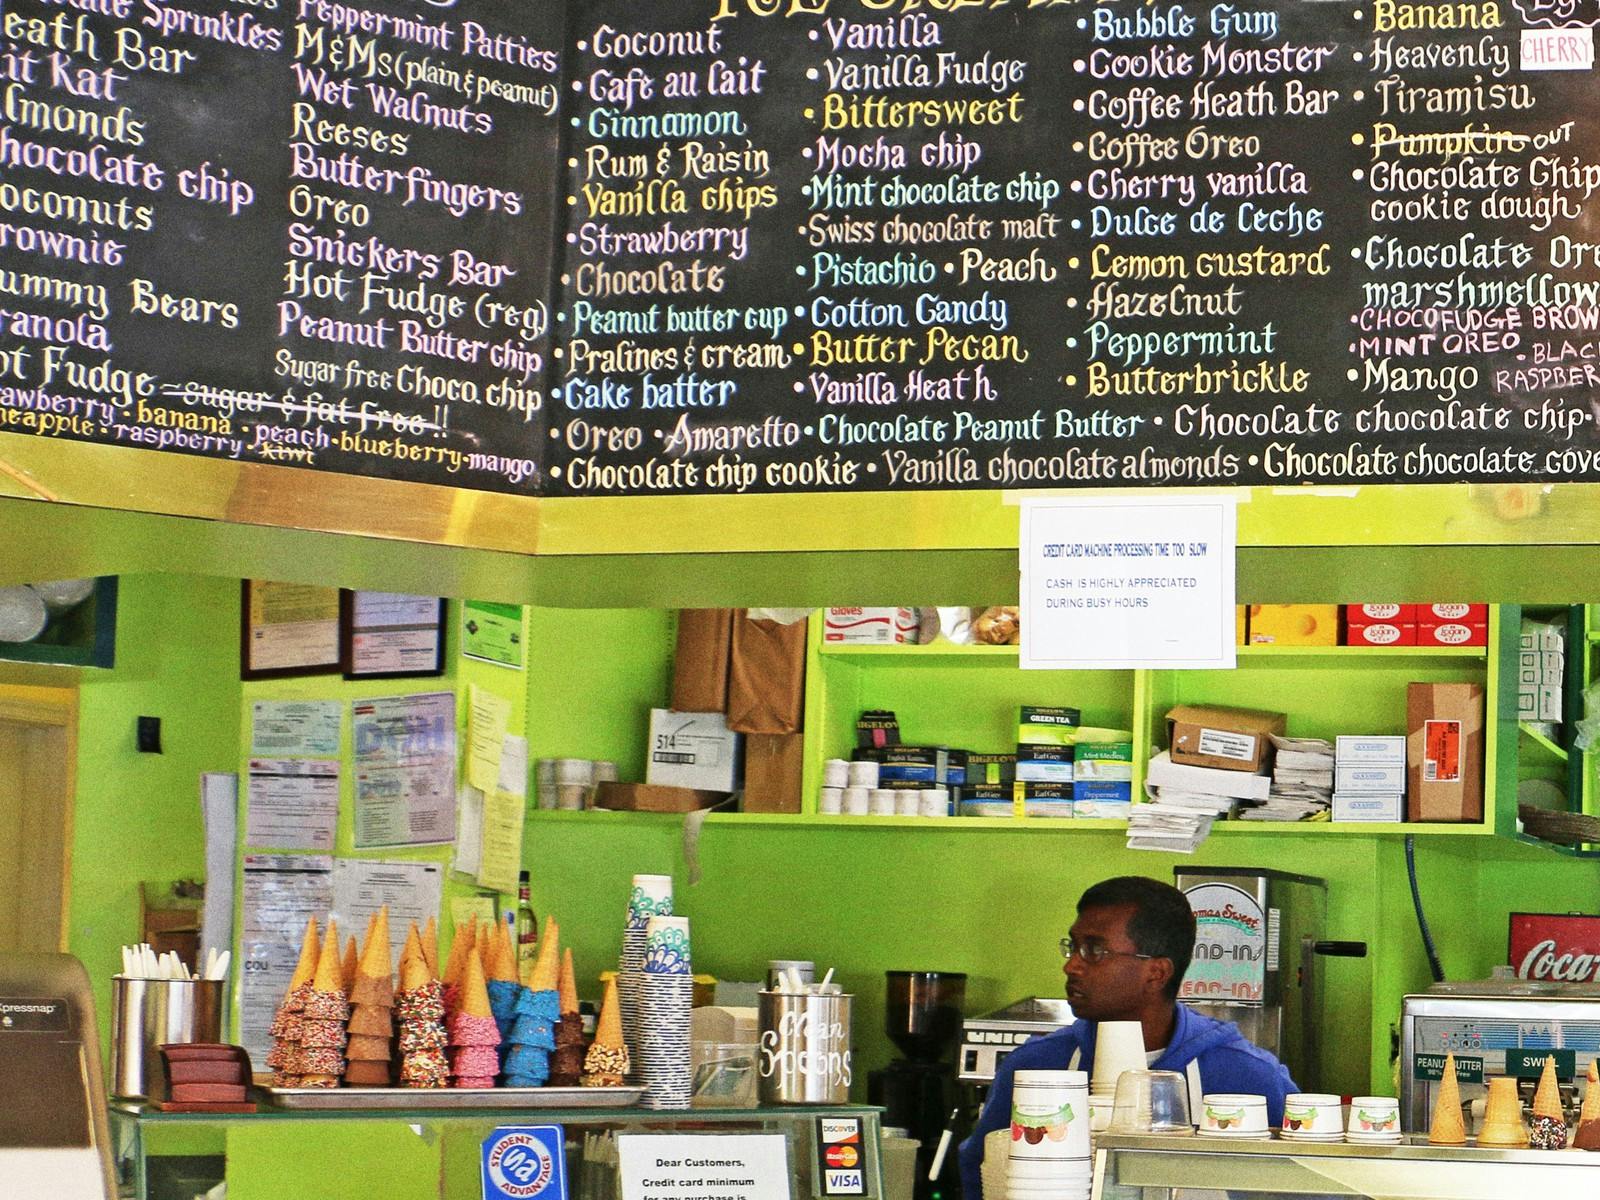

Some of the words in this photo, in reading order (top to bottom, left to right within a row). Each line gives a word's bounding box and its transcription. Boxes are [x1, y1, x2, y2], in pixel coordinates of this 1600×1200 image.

[593, 23, 723, 58] Coconut
[822, 13, 942, 51] Vanilla
[1520, 36, 1593, 65] CHERRY
[821, 93, 1025, 131] Bittersweet
[1373, 75, 1536, 114] Tiramisu
[291, 103, 411, 156] Reeses
[588, 108, 748, 138] Cinnamon
[289, 143, 523, 218] Butterfingers
[289, 184, 370, 228] Oreo
[288, 222, 440, 279] Snickers
[448, 250, 517, 288] Bar
[579, 222, 749, 259] Strawberry
[575, 261, 725, 299] Chocolate
[809, 253, 936, 291] Pistachio
[959, 248, 1056, 284] Peach
[129, 279, 240, 329] Bears
[283, 260, 356, 302] Hot
[359, 272, 466, 331] Fudge
[1083, 326, 1279, 367] Peppermint
[1360, 334, 1436, 357] MINT
[1442, 332, 1520, 353] OREO
[565, 377, 632, 410] Cake
[641, 375, 737, 410] batter
[1087, 361, 1311, 398] Butterbrickle
[1362, 357, 1479, 400] Mango
[1046, 579, 1073, 588] CASH
[1078, 579, 1087, 588] IS
[1090, 578, 1125, 588] HIGHLY
[1128, 577, 1197, 588] APPRECIATED
[1046, 598, 1083, 608] DURING
[1087, 598, 1111, 608] BUSY
[1115, 597, 1149, 608] HOURS
[1030, 715, 1055, 723] GREEN
[1056, 716, 1070, 724] TEA
[657, 735, 675, 749] 514
[1417, 1058, 1446, 1069] PEANU
[1456, 1060, 1481, 1071] UTTER
[1523, 1057, 1559, 1067] SWIL
[492, 1136, 532, 1167] STUDENT
[655, 1158, 681, 1168] Dear
[684, 1158, 745, 1169] Customers,
[501, 1155, 550, 1195] ADVANTAGE
[642, 1178, 675, 1188] Credit
[679, 1178, 703, 1187] card
[706, 1177, 755, 1187] minimum
[829, 1175, 860, 1187] VISA
